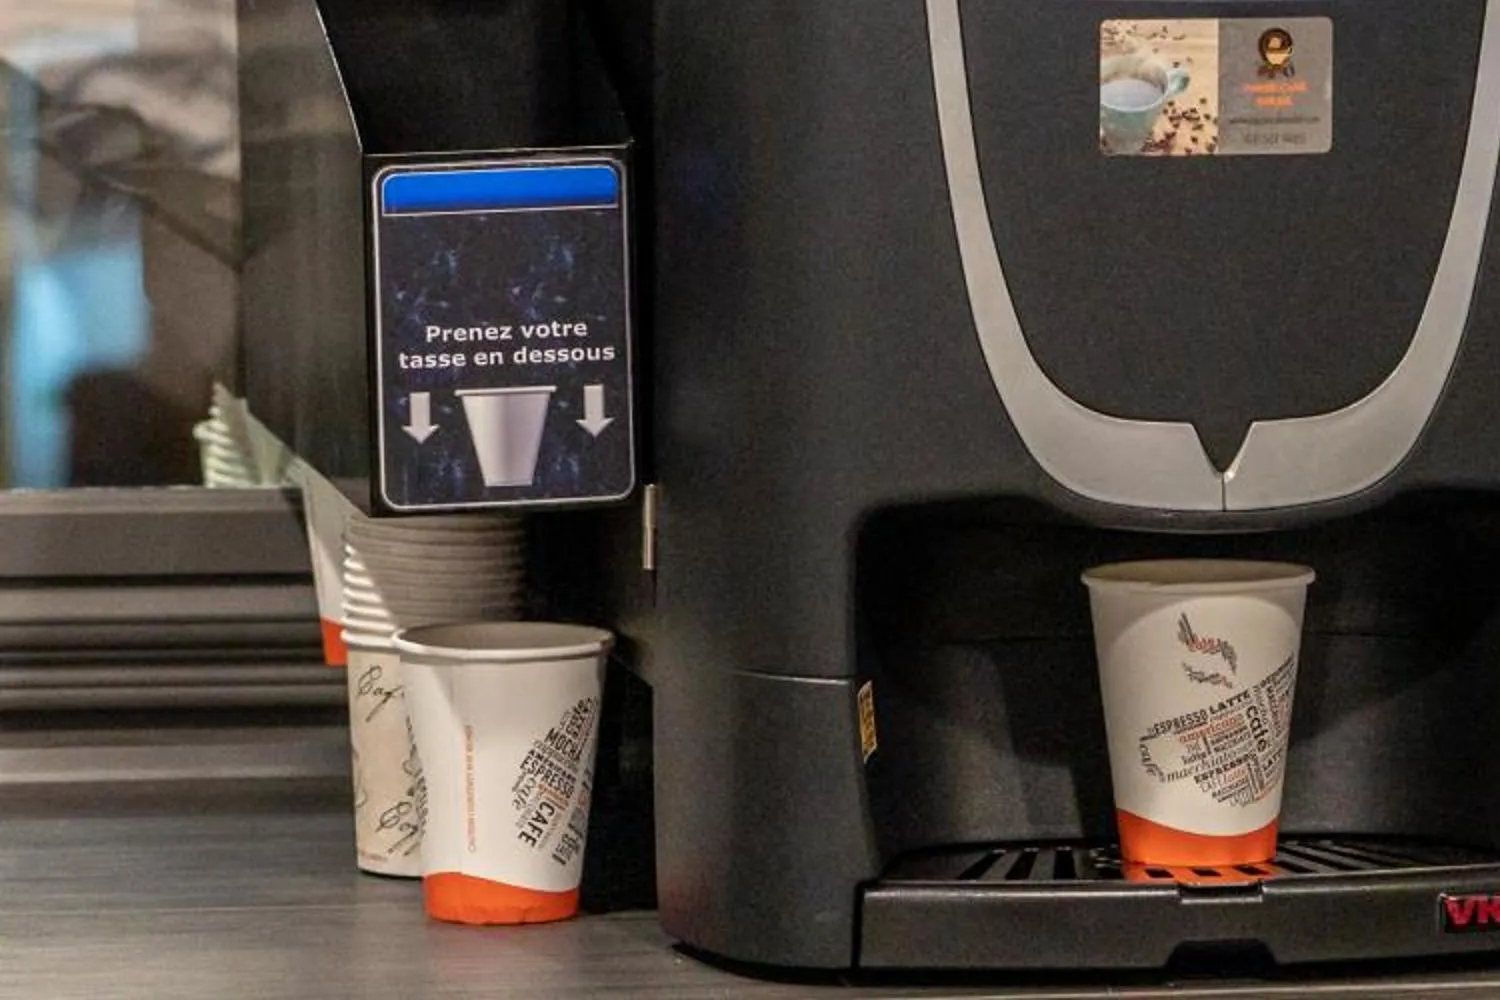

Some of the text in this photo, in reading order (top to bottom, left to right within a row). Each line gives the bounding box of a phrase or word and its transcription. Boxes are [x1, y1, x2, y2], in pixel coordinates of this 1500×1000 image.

[426, 321, 588, 343] Prenez votre
[399, 345, 615, 369] tasse en dessous
[1209, 689, 1250, 715] LATTE
[1153, 709, 1208, 736] ESPRESSO
[520, 753, 575, 799] ESPRESSO
[518, 801, 555, 848] CAFE
